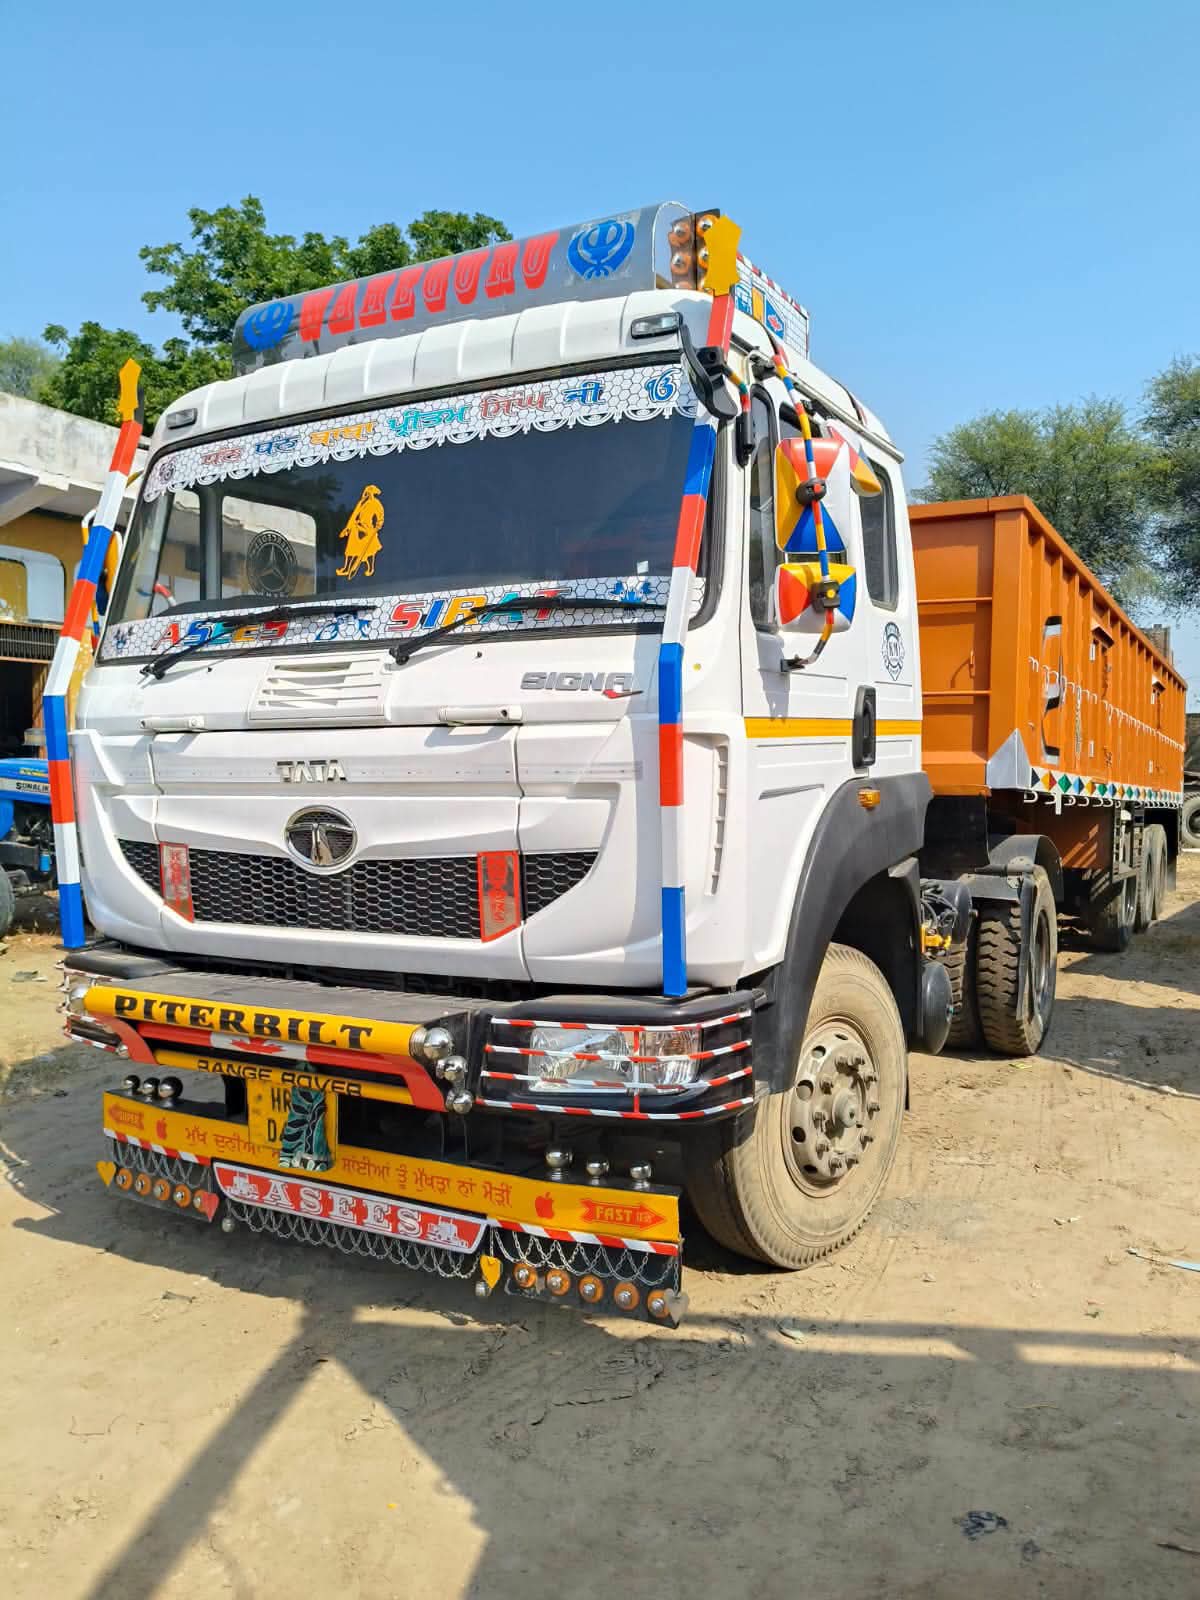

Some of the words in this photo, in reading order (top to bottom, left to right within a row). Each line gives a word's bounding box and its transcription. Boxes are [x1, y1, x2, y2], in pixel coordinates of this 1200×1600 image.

[520, 671, 634, 692] SIGNA
[277, 760, 347, 783] TATA
[114, 994, 373, 1051] PITERBILT
[197, 1059, 273, 1083] RANGE
[280, 1071, 362, 1097] ROVER
[261, 1178, 423, 1236] ASEES
[595, 1204, 633, 1223] FAST
